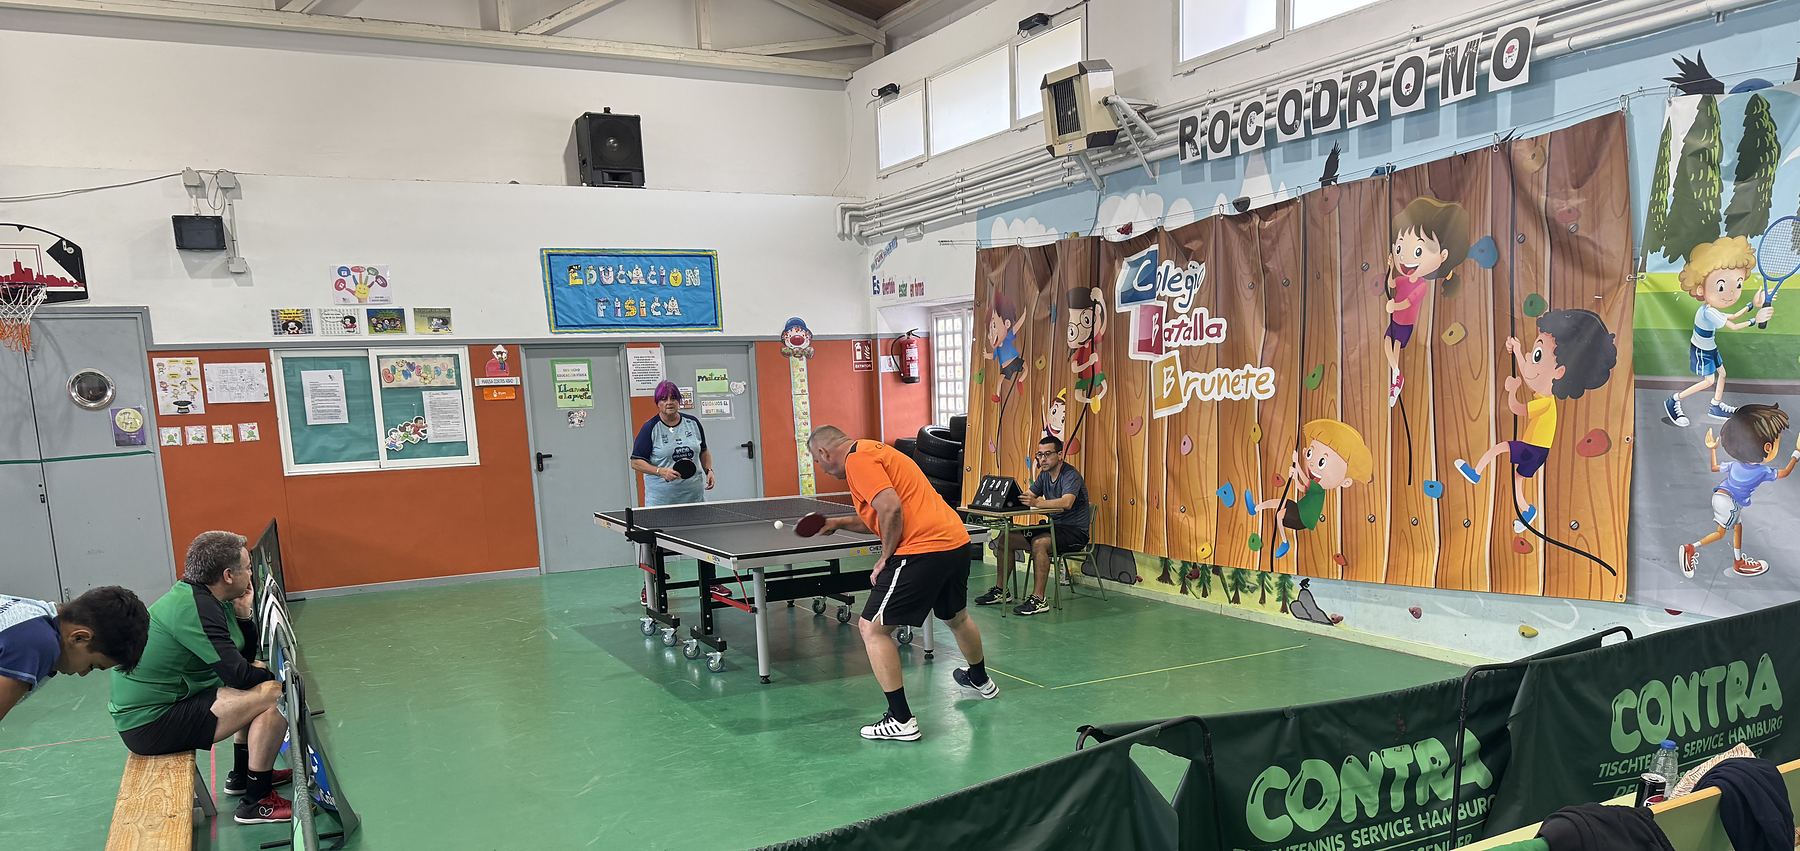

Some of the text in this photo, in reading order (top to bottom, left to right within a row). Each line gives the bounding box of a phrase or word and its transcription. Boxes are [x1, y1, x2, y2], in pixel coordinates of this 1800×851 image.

[1178, 26, 1532, 161] ROCODROMO
[567, 264, 701, 287] EDUCACION
[1132, 259, 1205, 308] Colegio
[595, 296, 682, 318] FISICA
[1151, 312, 1223, 347] Batalla
[697, 373, 728, 382] Material
[1163, 366, 1271, 399] Brunete
[1610, 653, 1783, 754] CONTRA
[1682, 732, 1725, 758] SERVICE
[1728, 715, 1783, 745] HAMBURG
[1245, 728, 1493, 843] CONTRA
[1351, 817, 1414, 848] SERVICE
